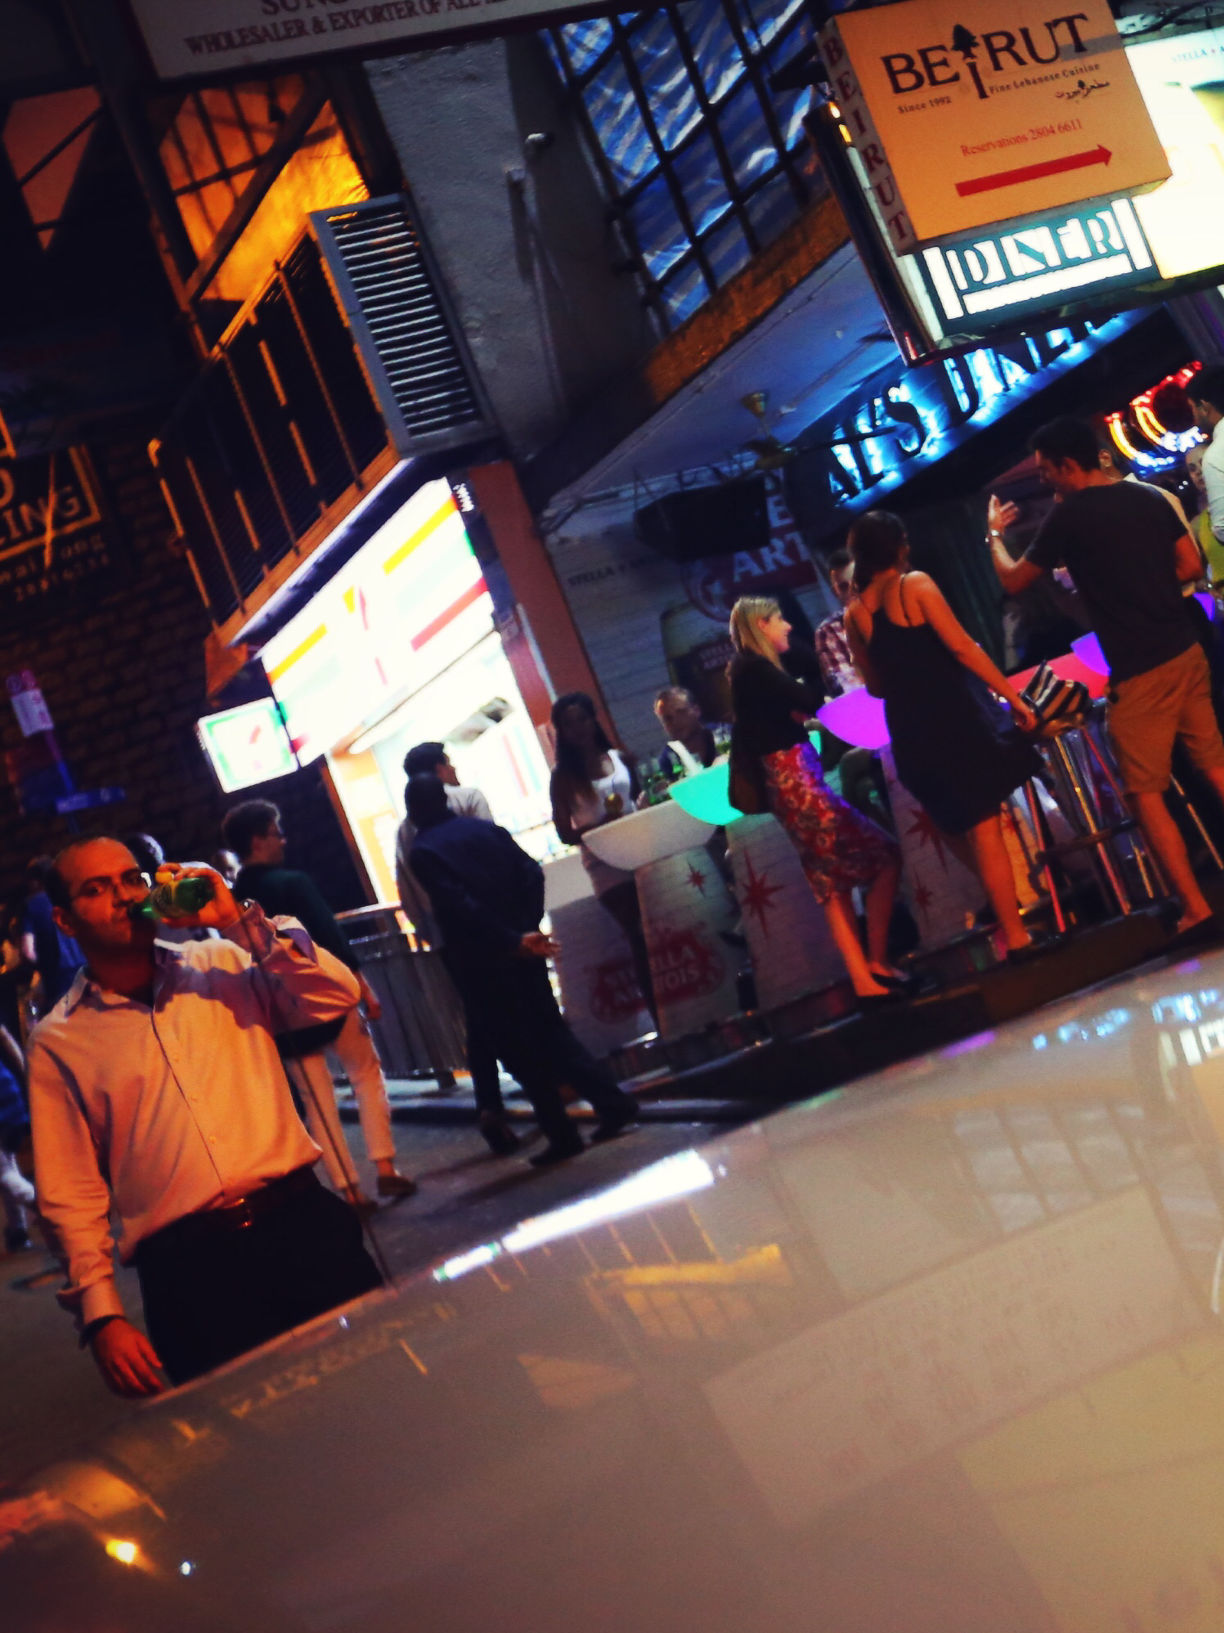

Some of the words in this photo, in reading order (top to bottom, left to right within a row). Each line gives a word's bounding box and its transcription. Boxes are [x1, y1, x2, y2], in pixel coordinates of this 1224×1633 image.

[184, 18, 309, 54] WHOLESALER
[312, 15, 327, 34] &
[328, 6, 418, 31] EXPORTER
[880, 13, 1089, 99] BEIRUT
[898, 102, 927, 115] Since
[929, 95, 953, 109] 1992
[989, 83, 1011, 95] Fine
[1013, 72, 1061, 90] Lebanese
[1062, 62, 1101, 79] Cuisine
[824, 37, 908, 240] BEIRUT
[960, 129, 1029, 157] Reservations
[1029, 123, 1056, 142] 2804
[1057, 118, 1084, 135] 6611
[944, 208, 1128, 291] DINER
[0, 484, 81, 545] ING
